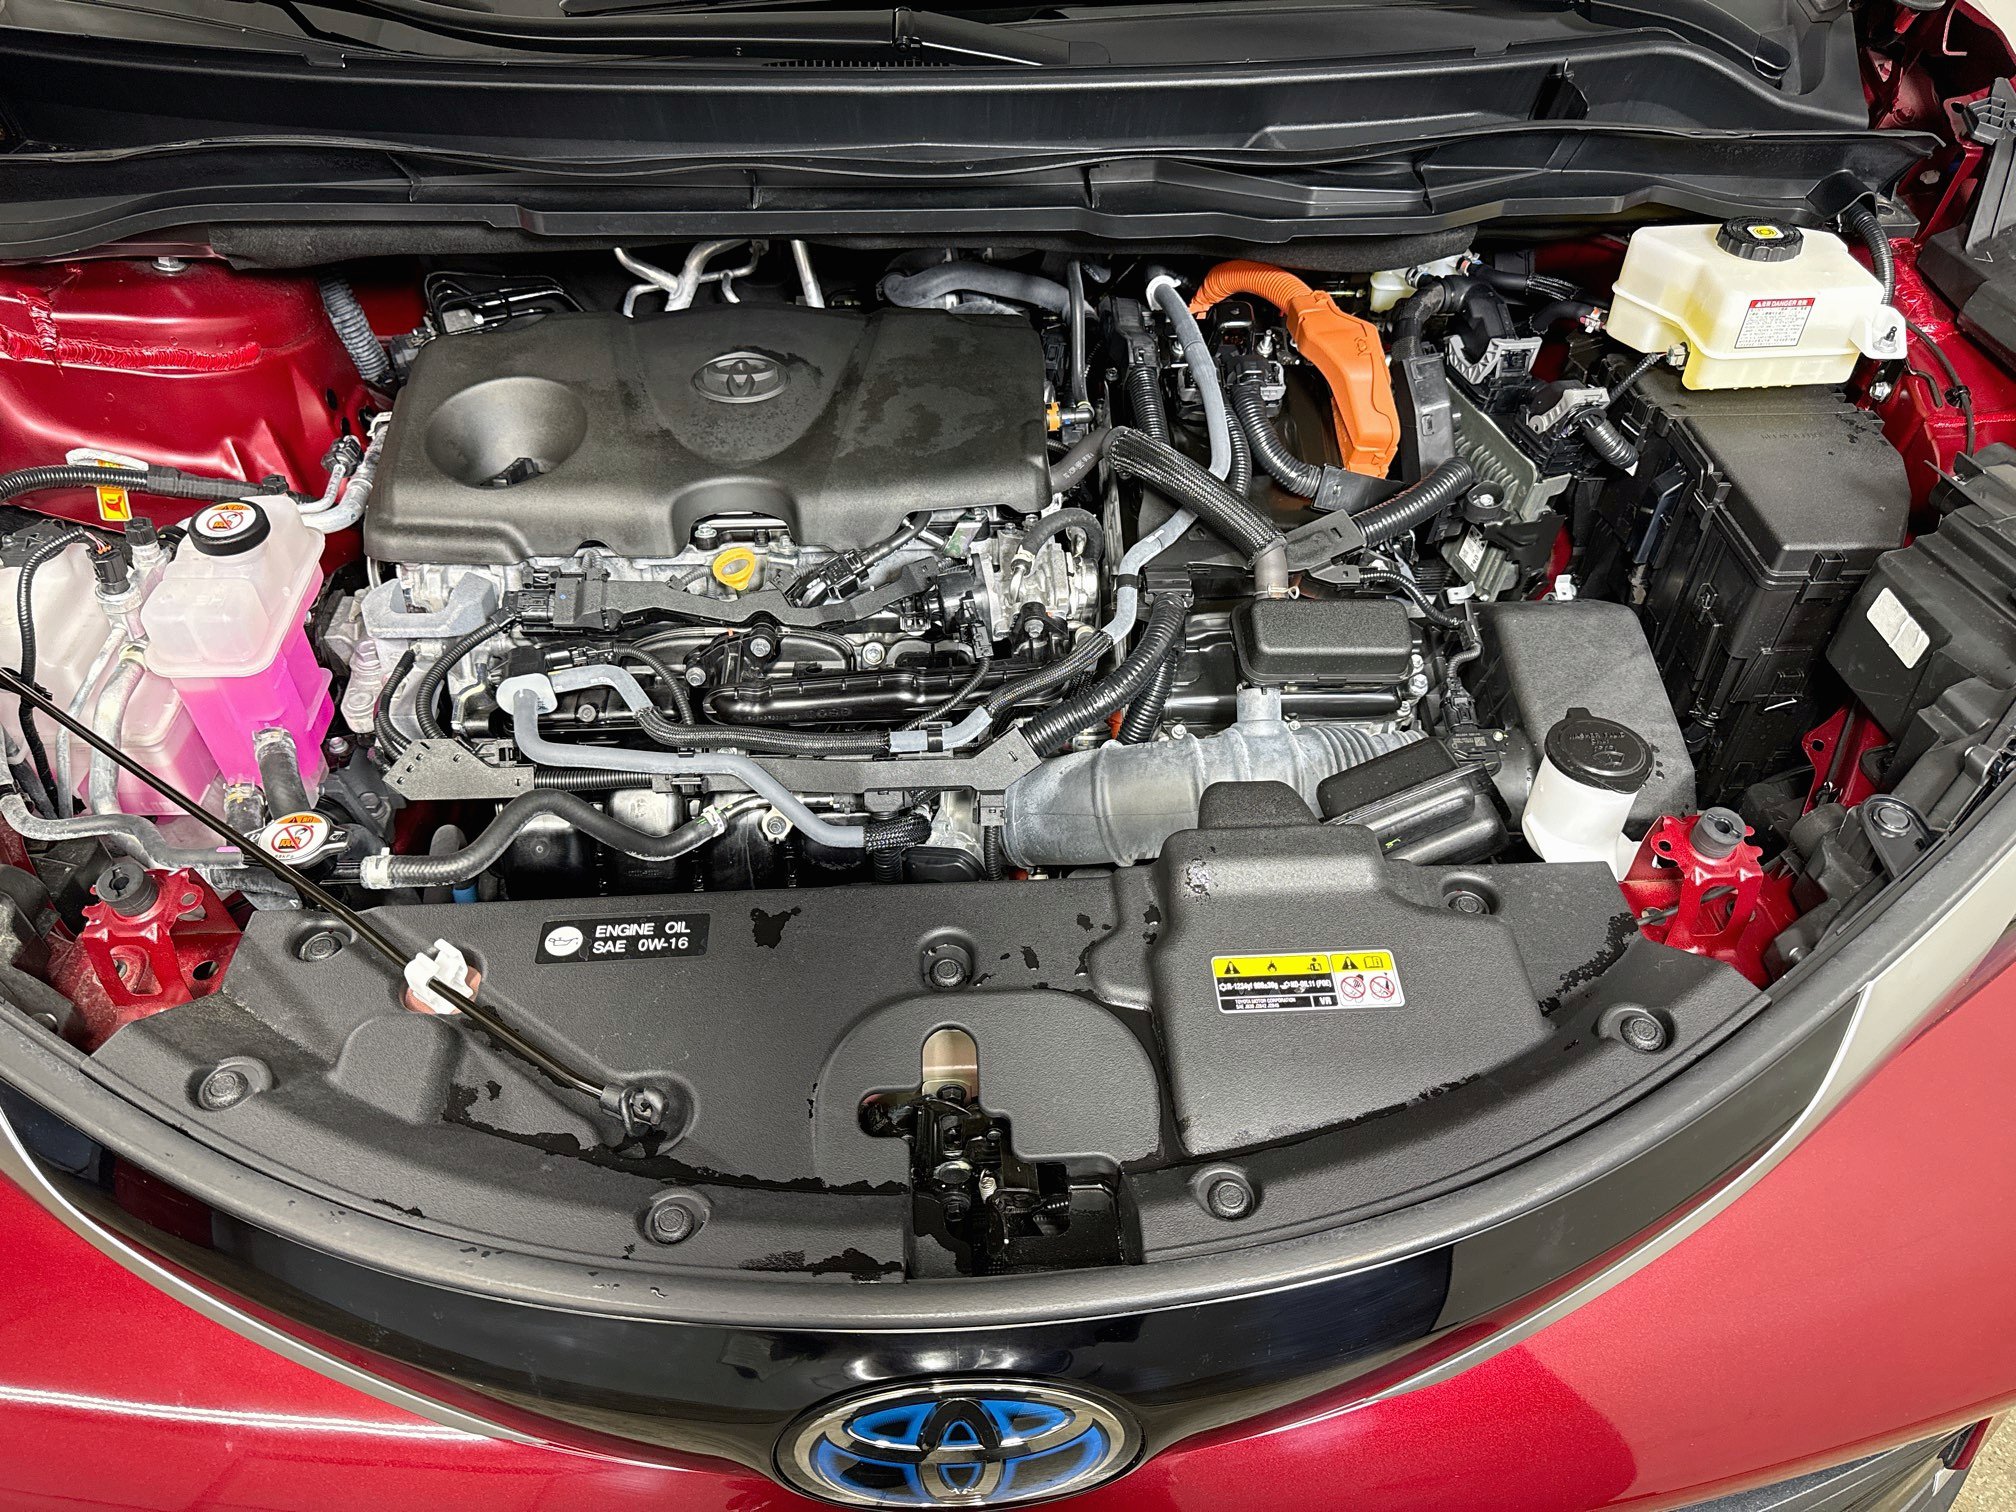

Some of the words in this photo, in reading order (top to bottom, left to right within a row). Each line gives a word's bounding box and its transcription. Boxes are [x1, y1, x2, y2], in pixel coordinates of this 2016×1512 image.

[595, 923, 655, 938] ENGINE
[664, 921, 691, 934] OIL
[592, 939, 627, 954] SAE
[637, 936, 689, 951] 0W-16
